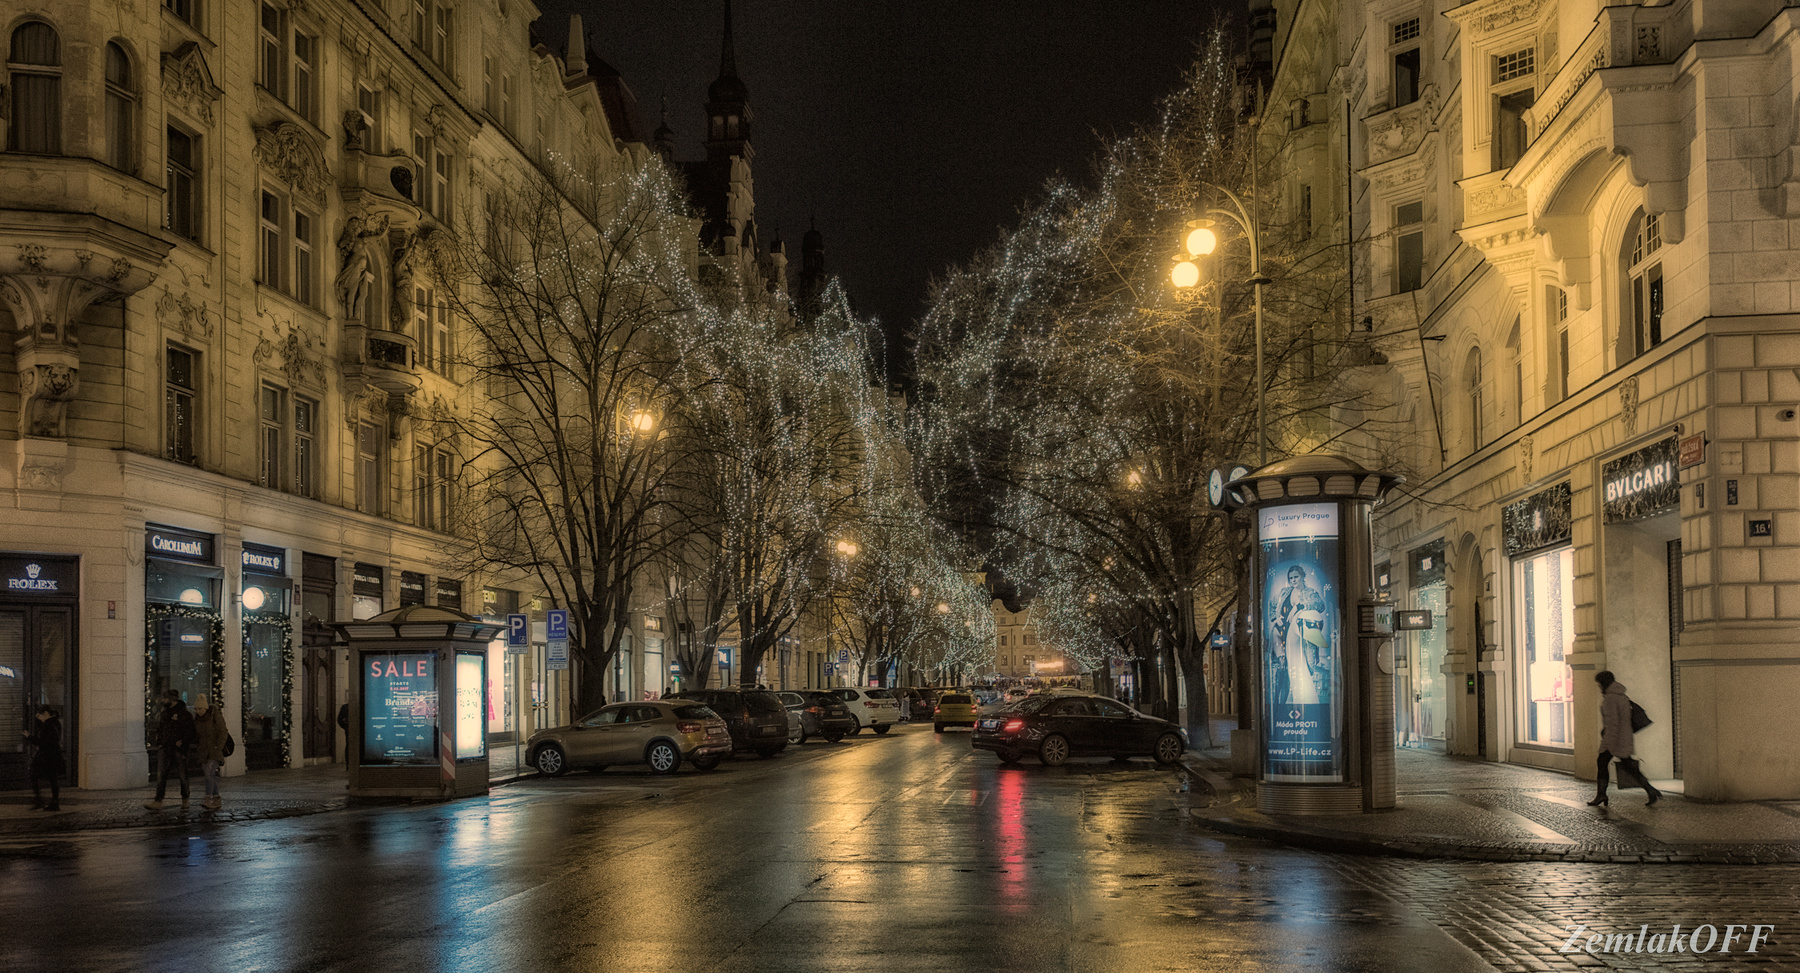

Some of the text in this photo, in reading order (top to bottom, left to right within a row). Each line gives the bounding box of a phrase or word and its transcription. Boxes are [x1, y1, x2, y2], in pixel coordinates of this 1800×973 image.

[1606, 460, 1671, 502] BVLGARI
[1302, 512, 1330, 520] Prague
[8, 578, 58, 590] ROLEX
[551, 613, 563, 631] P
[1408, 615, 1424, 625] WC
[511, 617, 524, 637] P
[371, 660, 428, 678] SALE
[385, 698, 414, 706] Brands
[1283, 728, 1308, 736] proudu
[1268, 747, 1332, 756] www.LP-Life.cz
